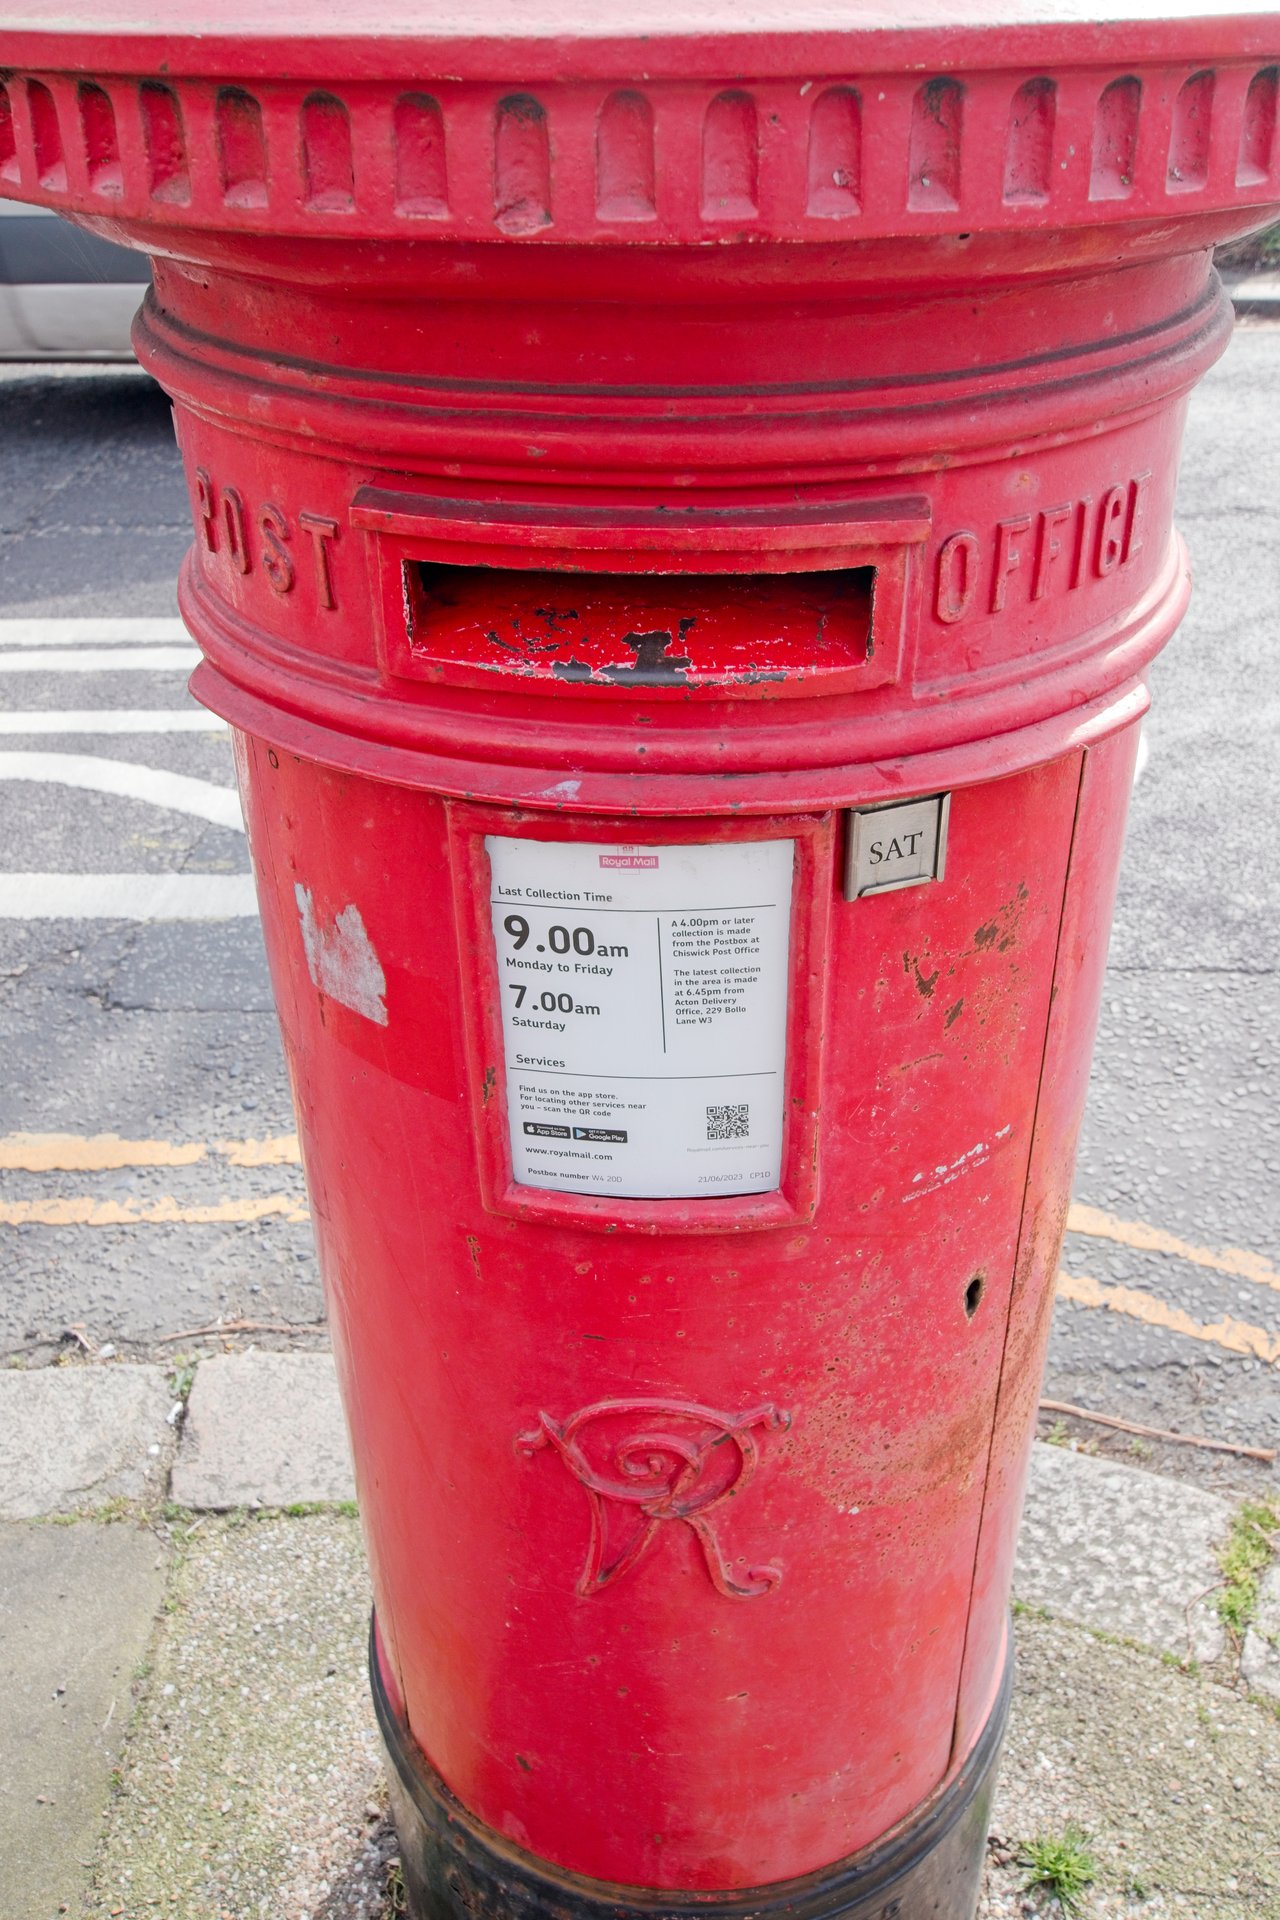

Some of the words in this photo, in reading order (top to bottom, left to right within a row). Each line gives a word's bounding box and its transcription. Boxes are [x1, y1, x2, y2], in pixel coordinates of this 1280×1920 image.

[195, 465, 340, 610] POST
[932, 471, 1152, 625] OFFICE
[869, 831, 924, 865] SAT
[602, 856, 631, 868] Royal
[633, 857, 657, 867] Mail
[498, 885, 522, 897] Last
[525, 887, 581, 901] Collection
[583, 891, 613, 903] Time
[680, 918, 719, 928] 4.00pm
[734, 917, 756, 925] later
[503, 914, 629, 957] 9.00am
[671, 930, 714, 938] collection
[716, 928, 724, 936] is
[727, 927, 751, 935] made
[696, 939, 711, 947] the
[713, 937, 748, 946] Postbox
[750, 936, 760, 944] at
[672, 948, 710, 957] Chiswick
[712, 948, 732, 956] Post
[734, 946, 760, 954] Office
[506, 957, 553, 974] Monday
[557, 963, 570, 973] to
[574, 963, 613, 977] Friday
[674, 969, 690, 977] The
[692, 968, 718, 976] latest
[720, 965, 761, 975] collection
[685, 978, 699, 986] the
[724, 976, 731, 984] is
[734, 975, 758, 983] made
[686, 987, 721, 996] 6.45pm
[724, 986, 745, 994] from
[508, 984, 601, 1015] 7.00am
[702, 997, 737, 1005] Delivery
[675, 1007, 704, 1016] Office,
[706, 1006, 722, 1014] 229
[725, 1005, 746, 1014] Bollo
[512, 1016, 566, 1032] Saturday
[676, 1017, 697, 1025] Lane
[699, 1016, 713, 1024] W3
[516, 1054, 566, 1068] Services
[519, 1085, 536, 1093] Find
[562, 1089, 576, 1097] the
[578, 1091, 593, 1099] app
[595, 1092, 618, 1100] store.
[535, 1095, 566, 1105] locating
[592, 1101, 626, 1109] services
[588, 1133, 611, 1141] Google
[525, 1147, 613, 1160] www.royalmail.com
[528, 1168, 558, 1177] Postbox
[559, 1172, 590, 1181] number
[697, 1173, 743, 1182] 21/06/2023
